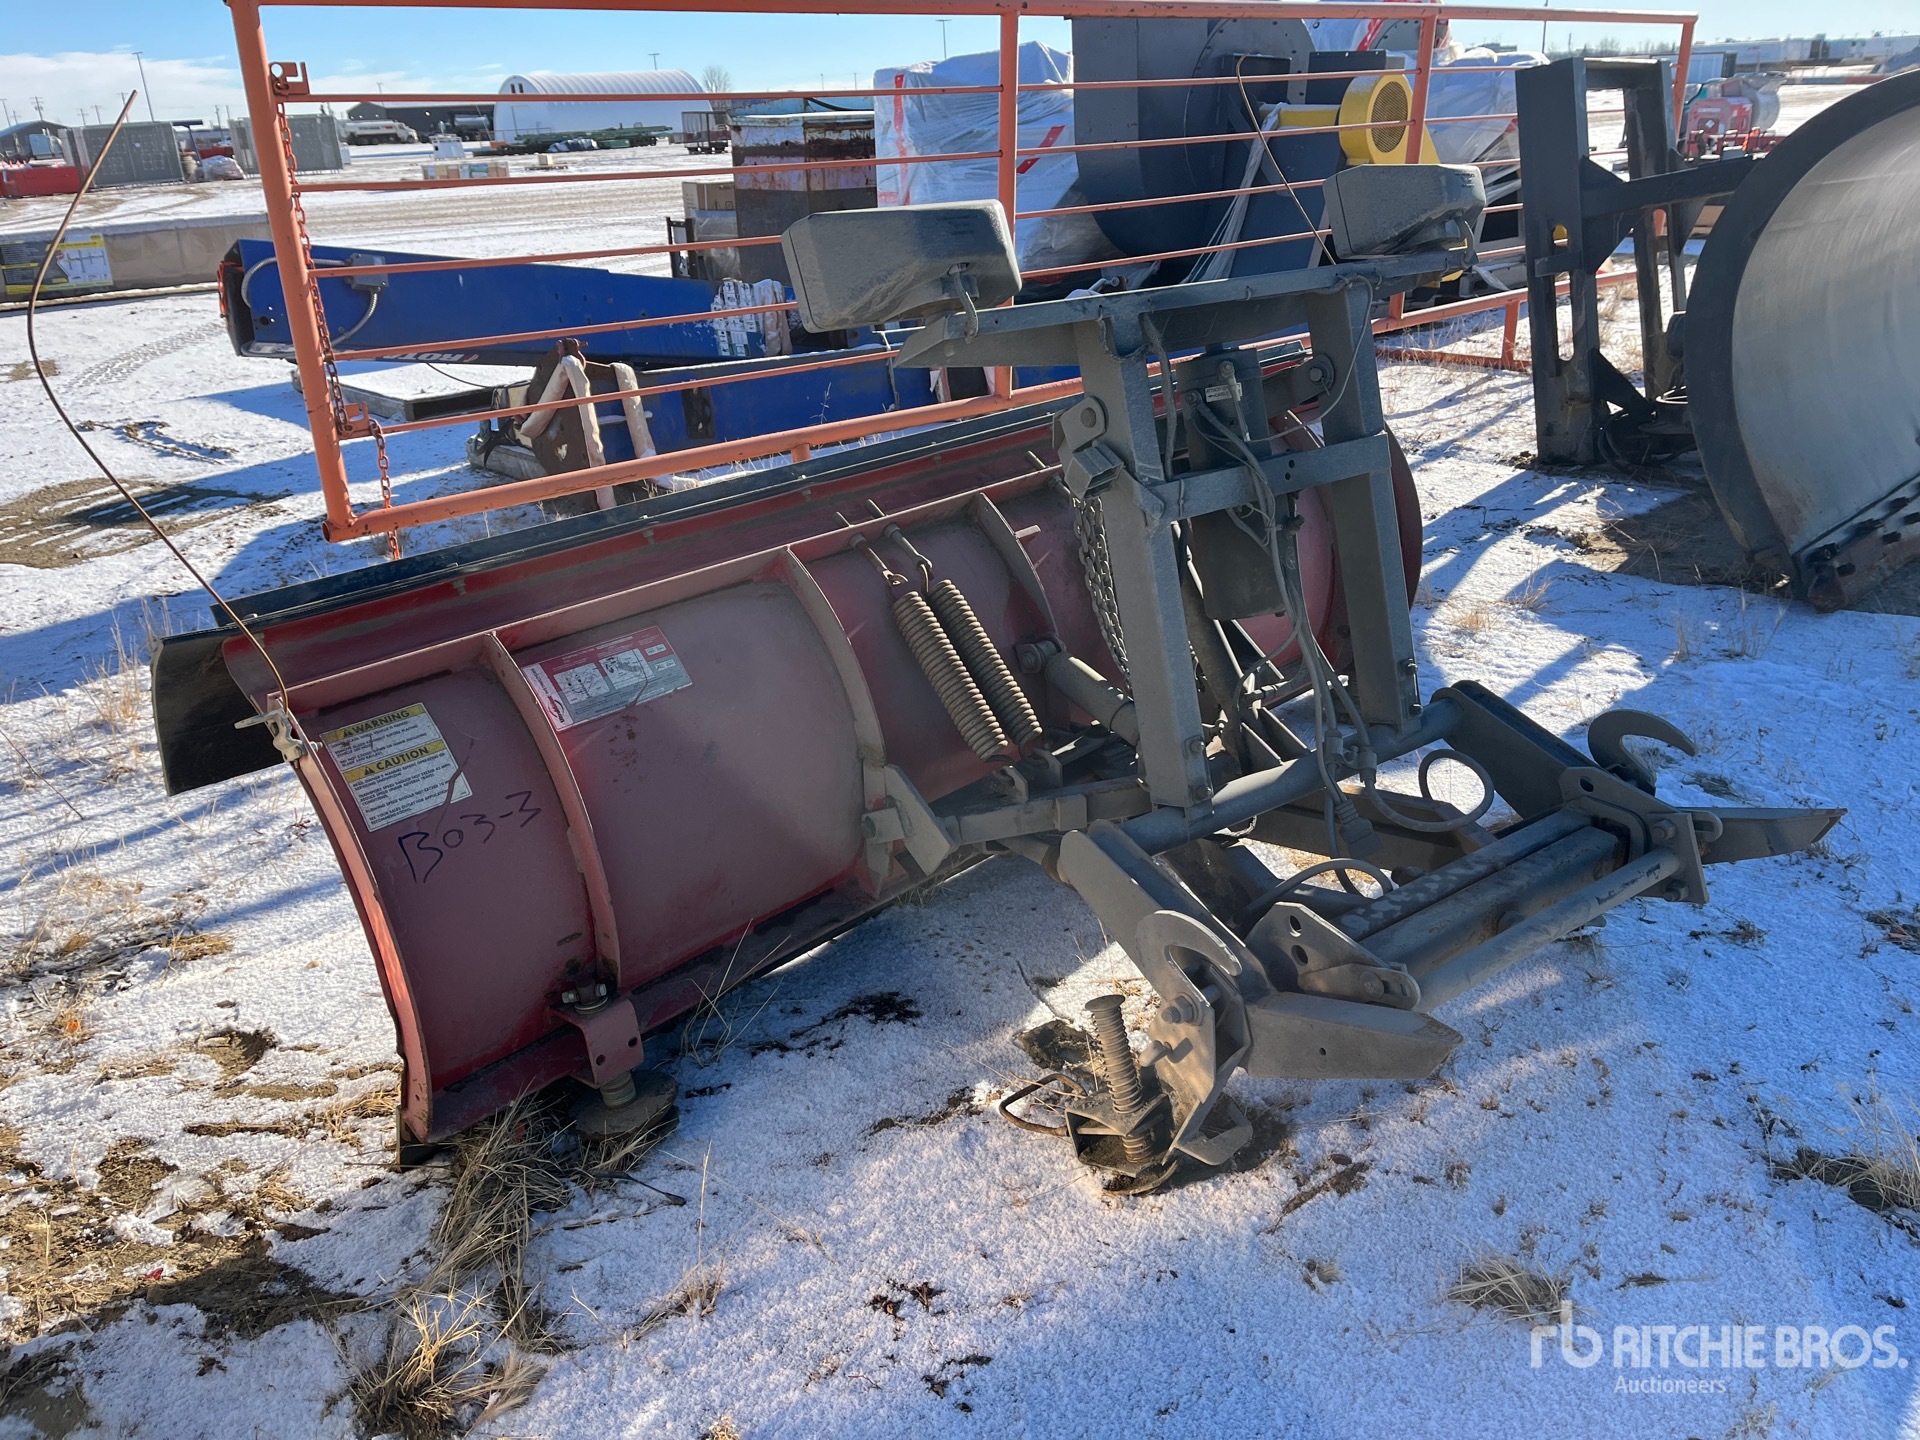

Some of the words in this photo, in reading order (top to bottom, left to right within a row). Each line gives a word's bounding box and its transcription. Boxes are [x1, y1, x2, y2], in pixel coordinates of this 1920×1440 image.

[351, 709, 410, 733] WARNING
[375, 746, 429, 770] CAUTION
[398, 790, 541, 884] B03-3
